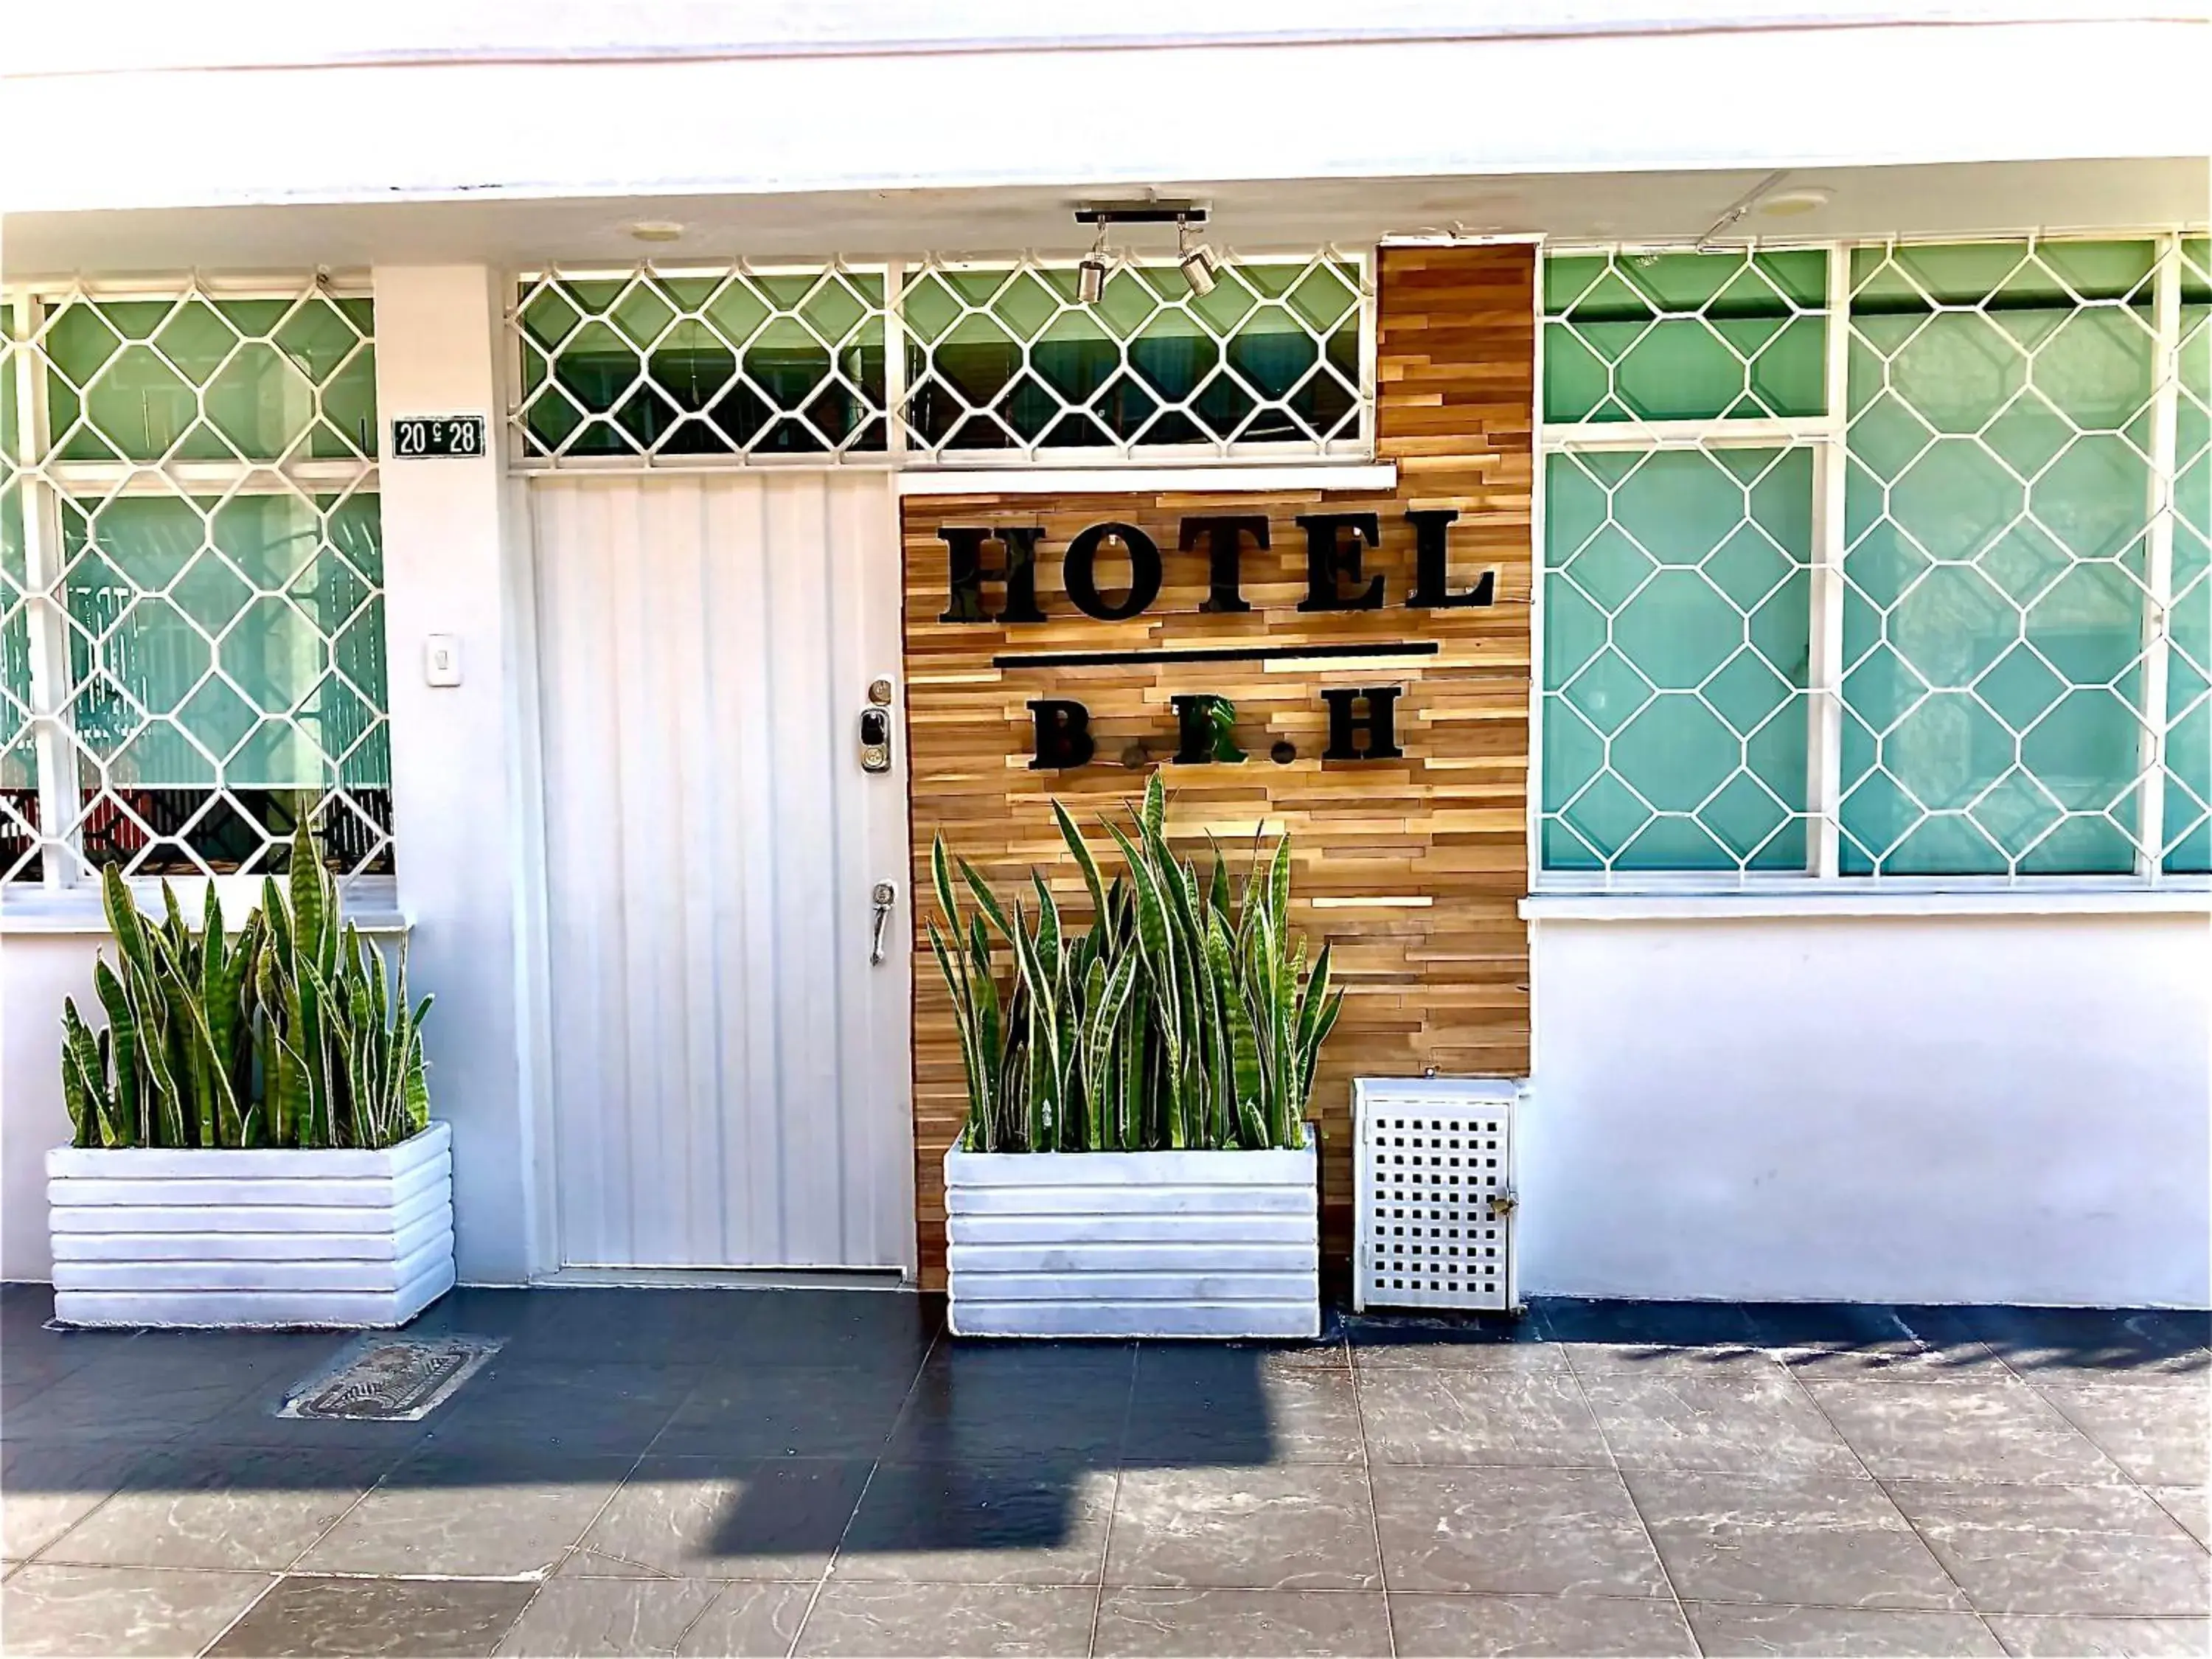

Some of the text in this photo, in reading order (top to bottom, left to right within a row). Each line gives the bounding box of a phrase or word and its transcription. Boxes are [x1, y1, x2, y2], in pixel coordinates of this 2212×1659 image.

[400, 422, 425, 452] 20
[449, 422, 474, 452] 28
[937, 509, 1494, 623] HOTEL
